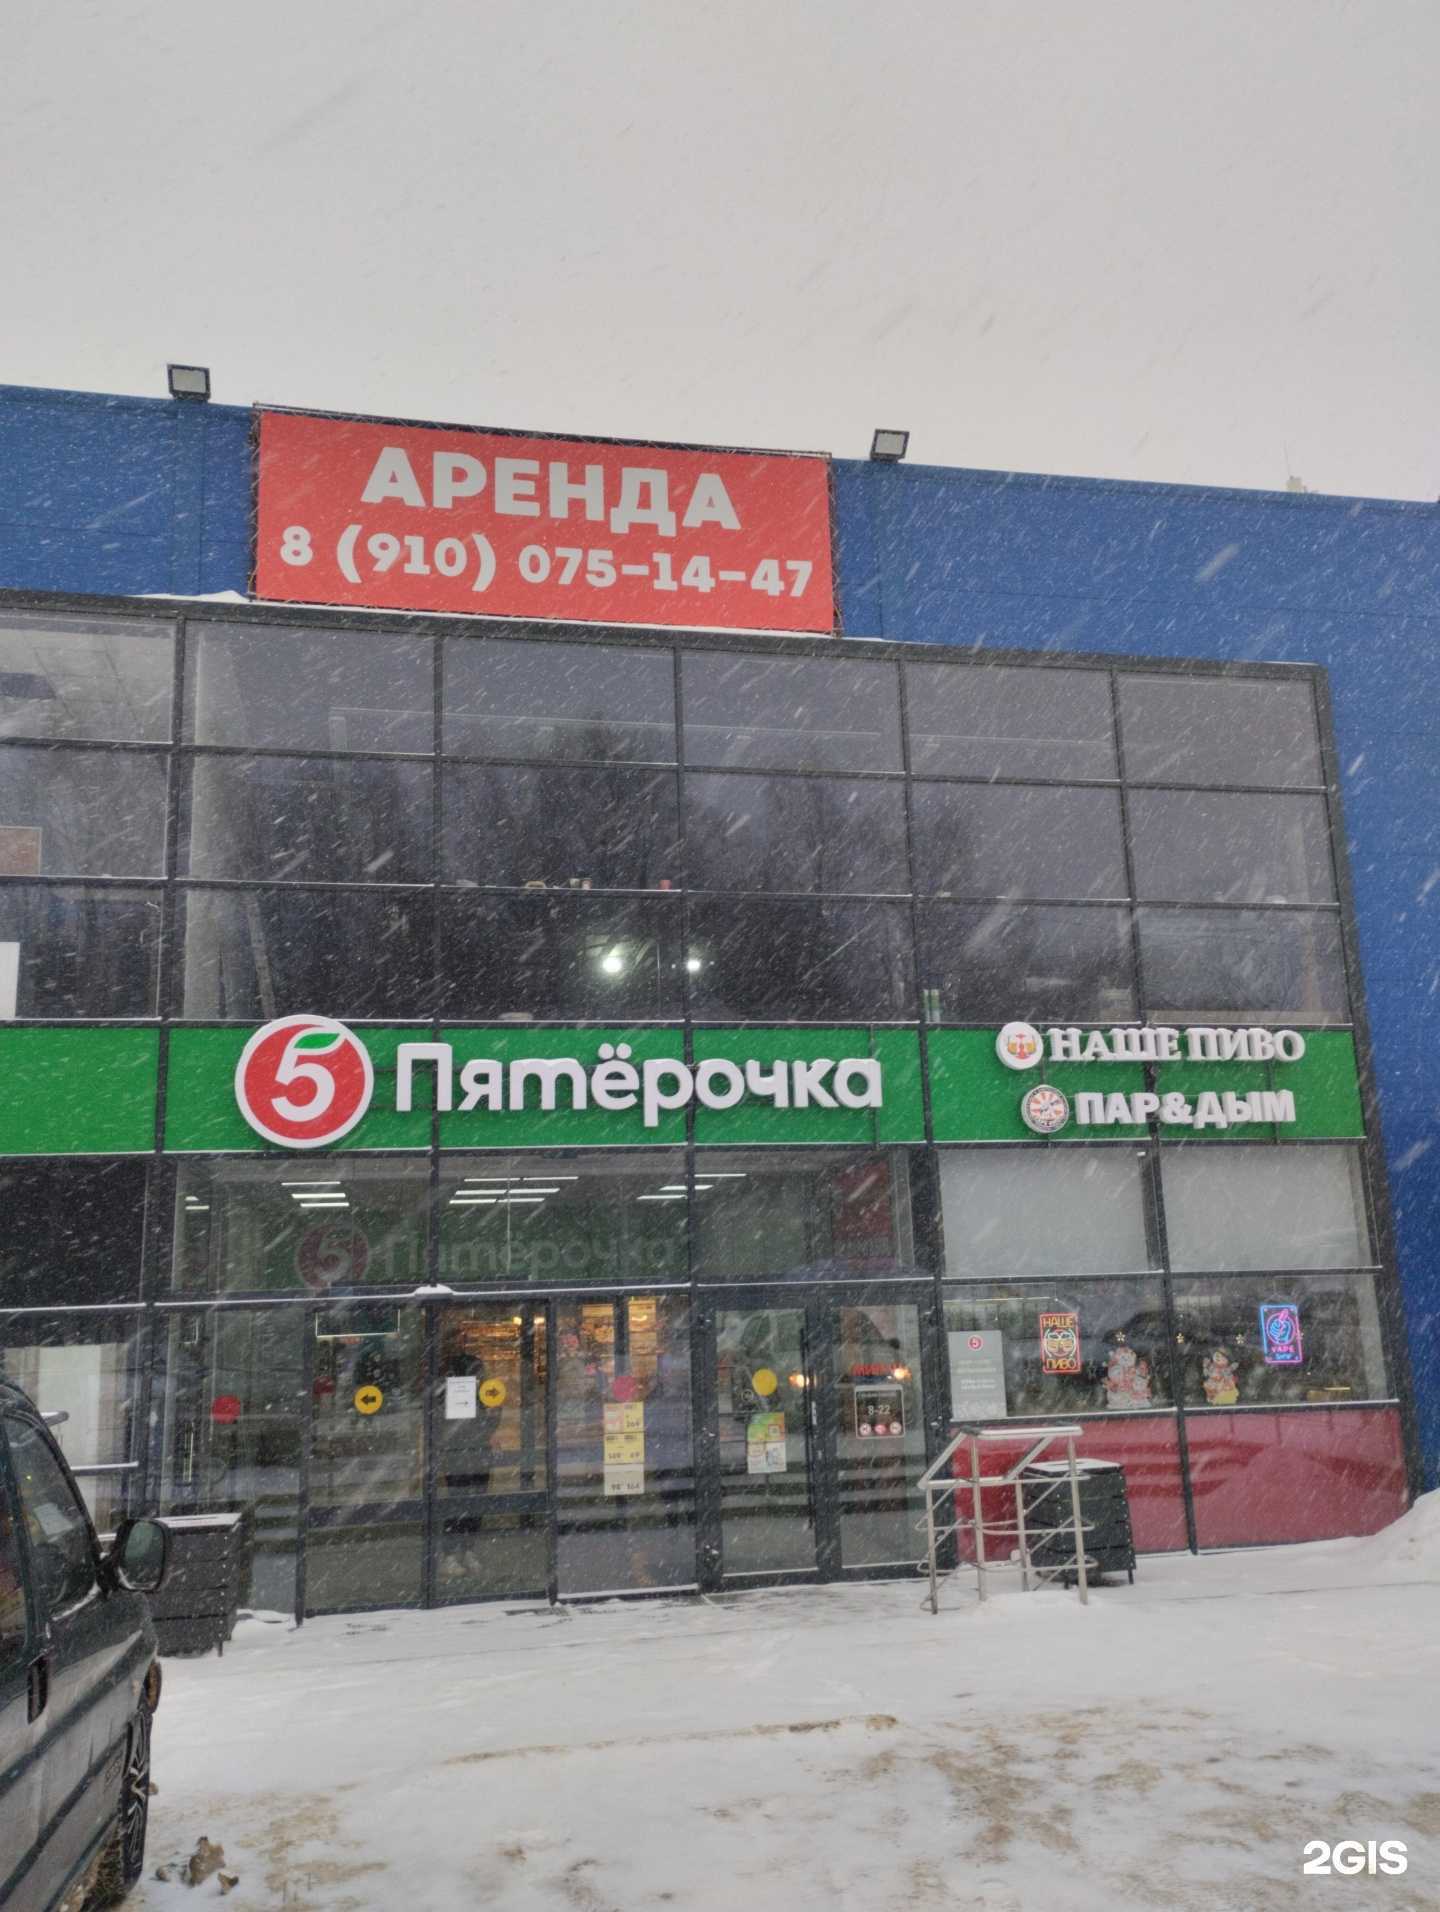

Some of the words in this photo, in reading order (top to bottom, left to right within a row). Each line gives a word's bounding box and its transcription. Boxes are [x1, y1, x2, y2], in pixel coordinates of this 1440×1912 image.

[361, 446, 741, 537] АРЕНДА
[280, 526, 314, 567] 8
[337, 524, 497, 592] (910)
[519, 544, 813, 598] 075-14-47
[1047, 1027, 1181, 1062] НАШЕ
[1185, 1027, 1306, 1062] ПИВО
[271, 1032, 345, 1122] 5
[396, 1042, 883, 1127] Пятёрочка
[1074, 1089, 1296, 1130] ПАР&ДЫМ
[1043, 1316, 1073, 1328] НАШЕ
[1046, 1358, 1077, 1370] ПИВО
